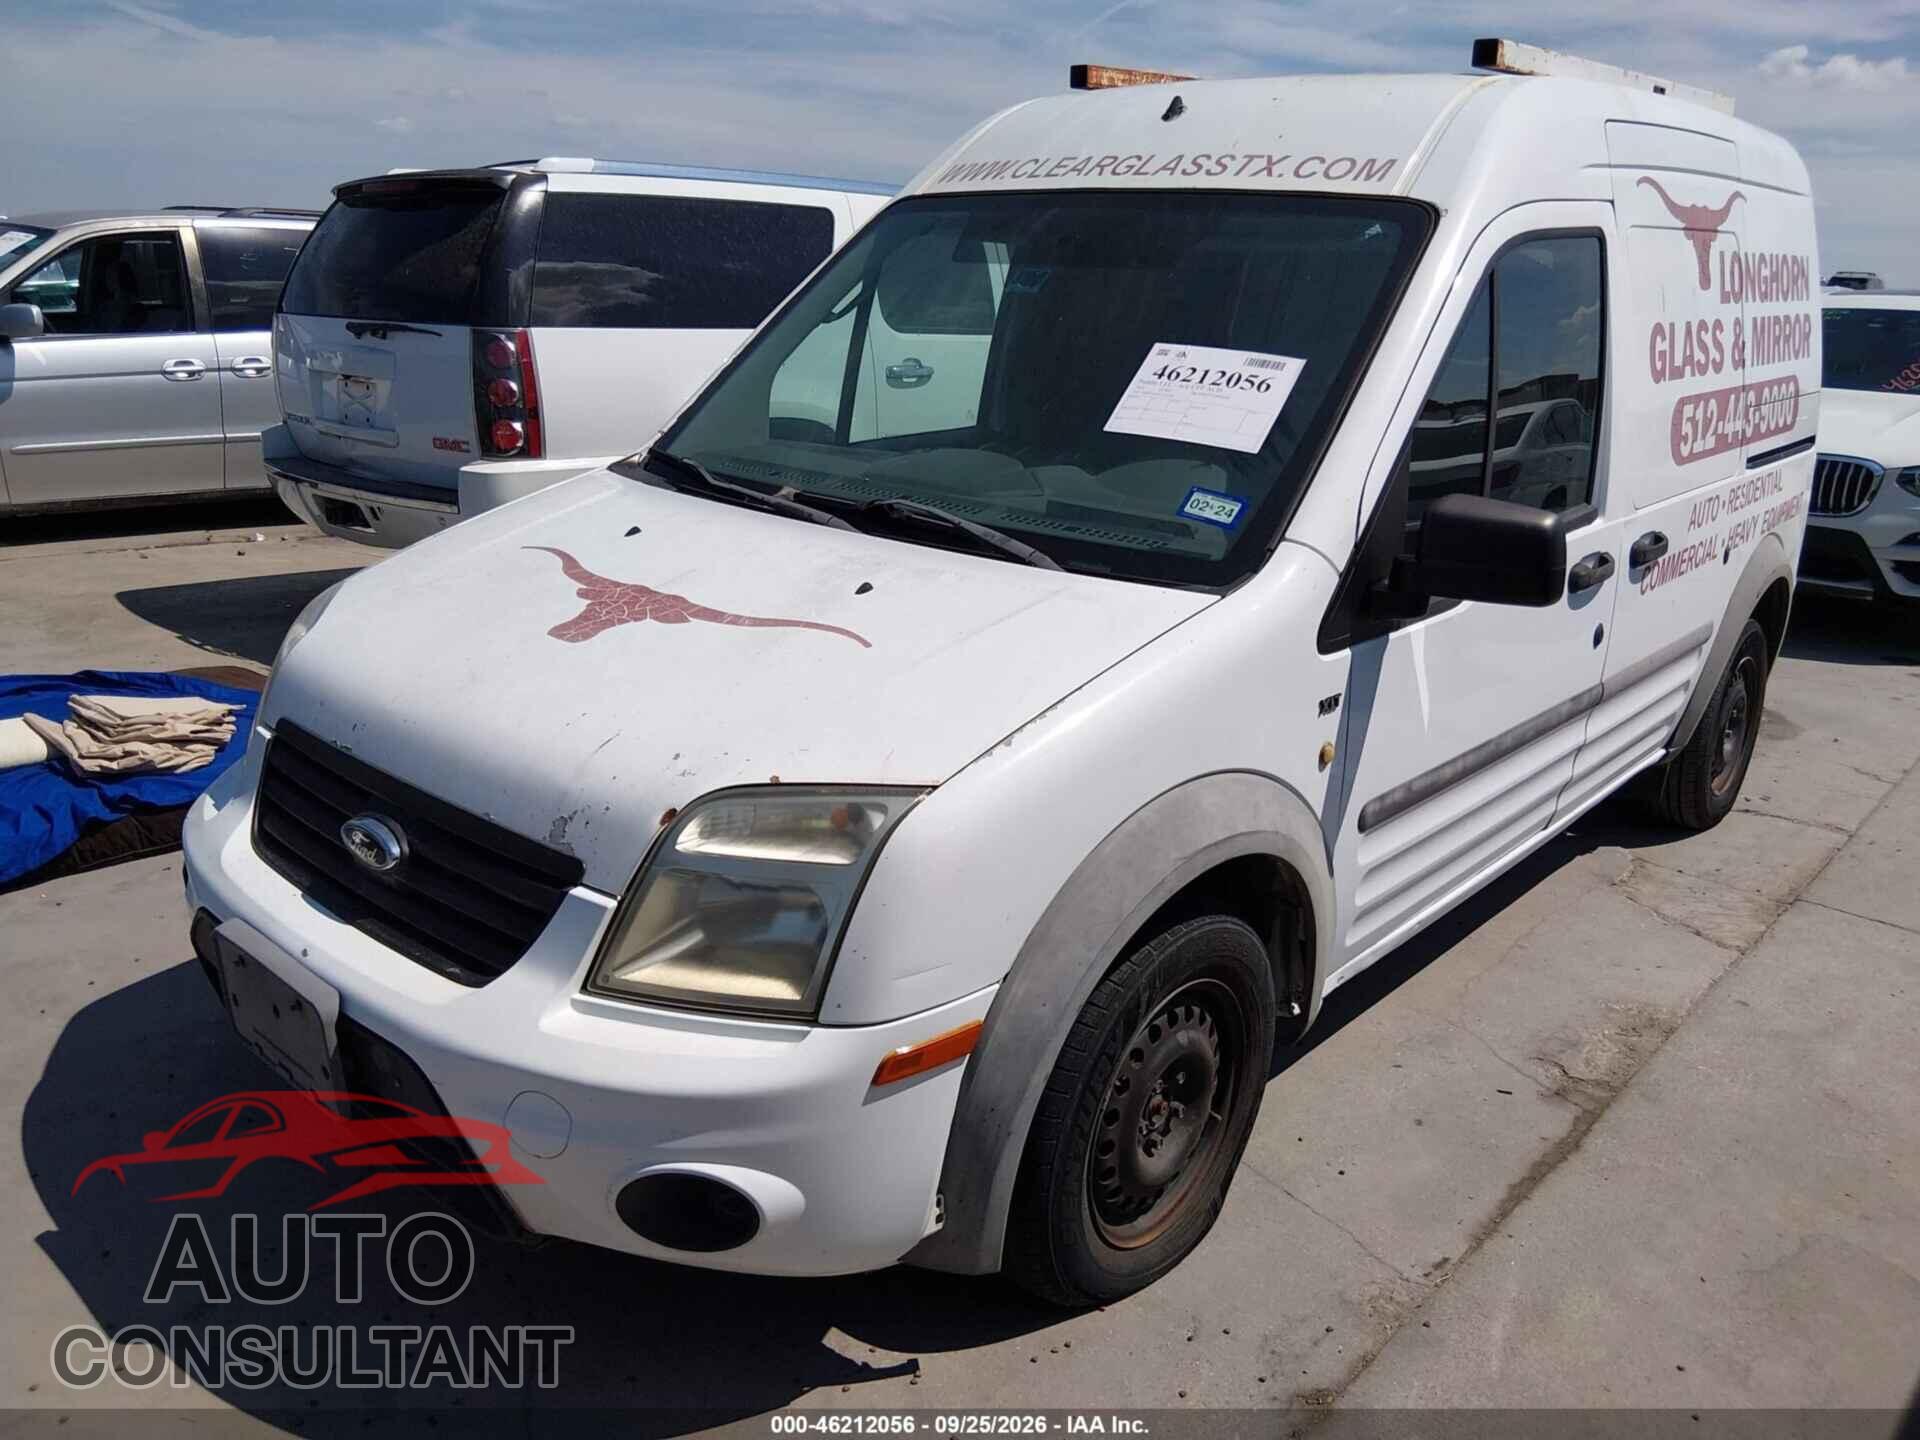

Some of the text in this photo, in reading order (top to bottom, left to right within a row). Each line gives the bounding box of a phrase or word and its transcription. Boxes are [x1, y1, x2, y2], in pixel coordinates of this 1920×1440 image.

[938, 154, 1397, 184] WWW.CLEARGLASSTX.COM
[1719, 250, 1810, 304] LONGHORN
[1650, 313, 1812, 384] GLASS & MIRROR
[1153, 364, 1276, 394] 46212056
[432, 437, 471, 453] GMC
[1680, 381, 1795, 457] 512-443-9000
[1688, 468, 1784, 533] AUTO RESIDENTIAL
[1640, 491, 1805, 596] COMMERCIAL HEAVY EQUIPMENT
